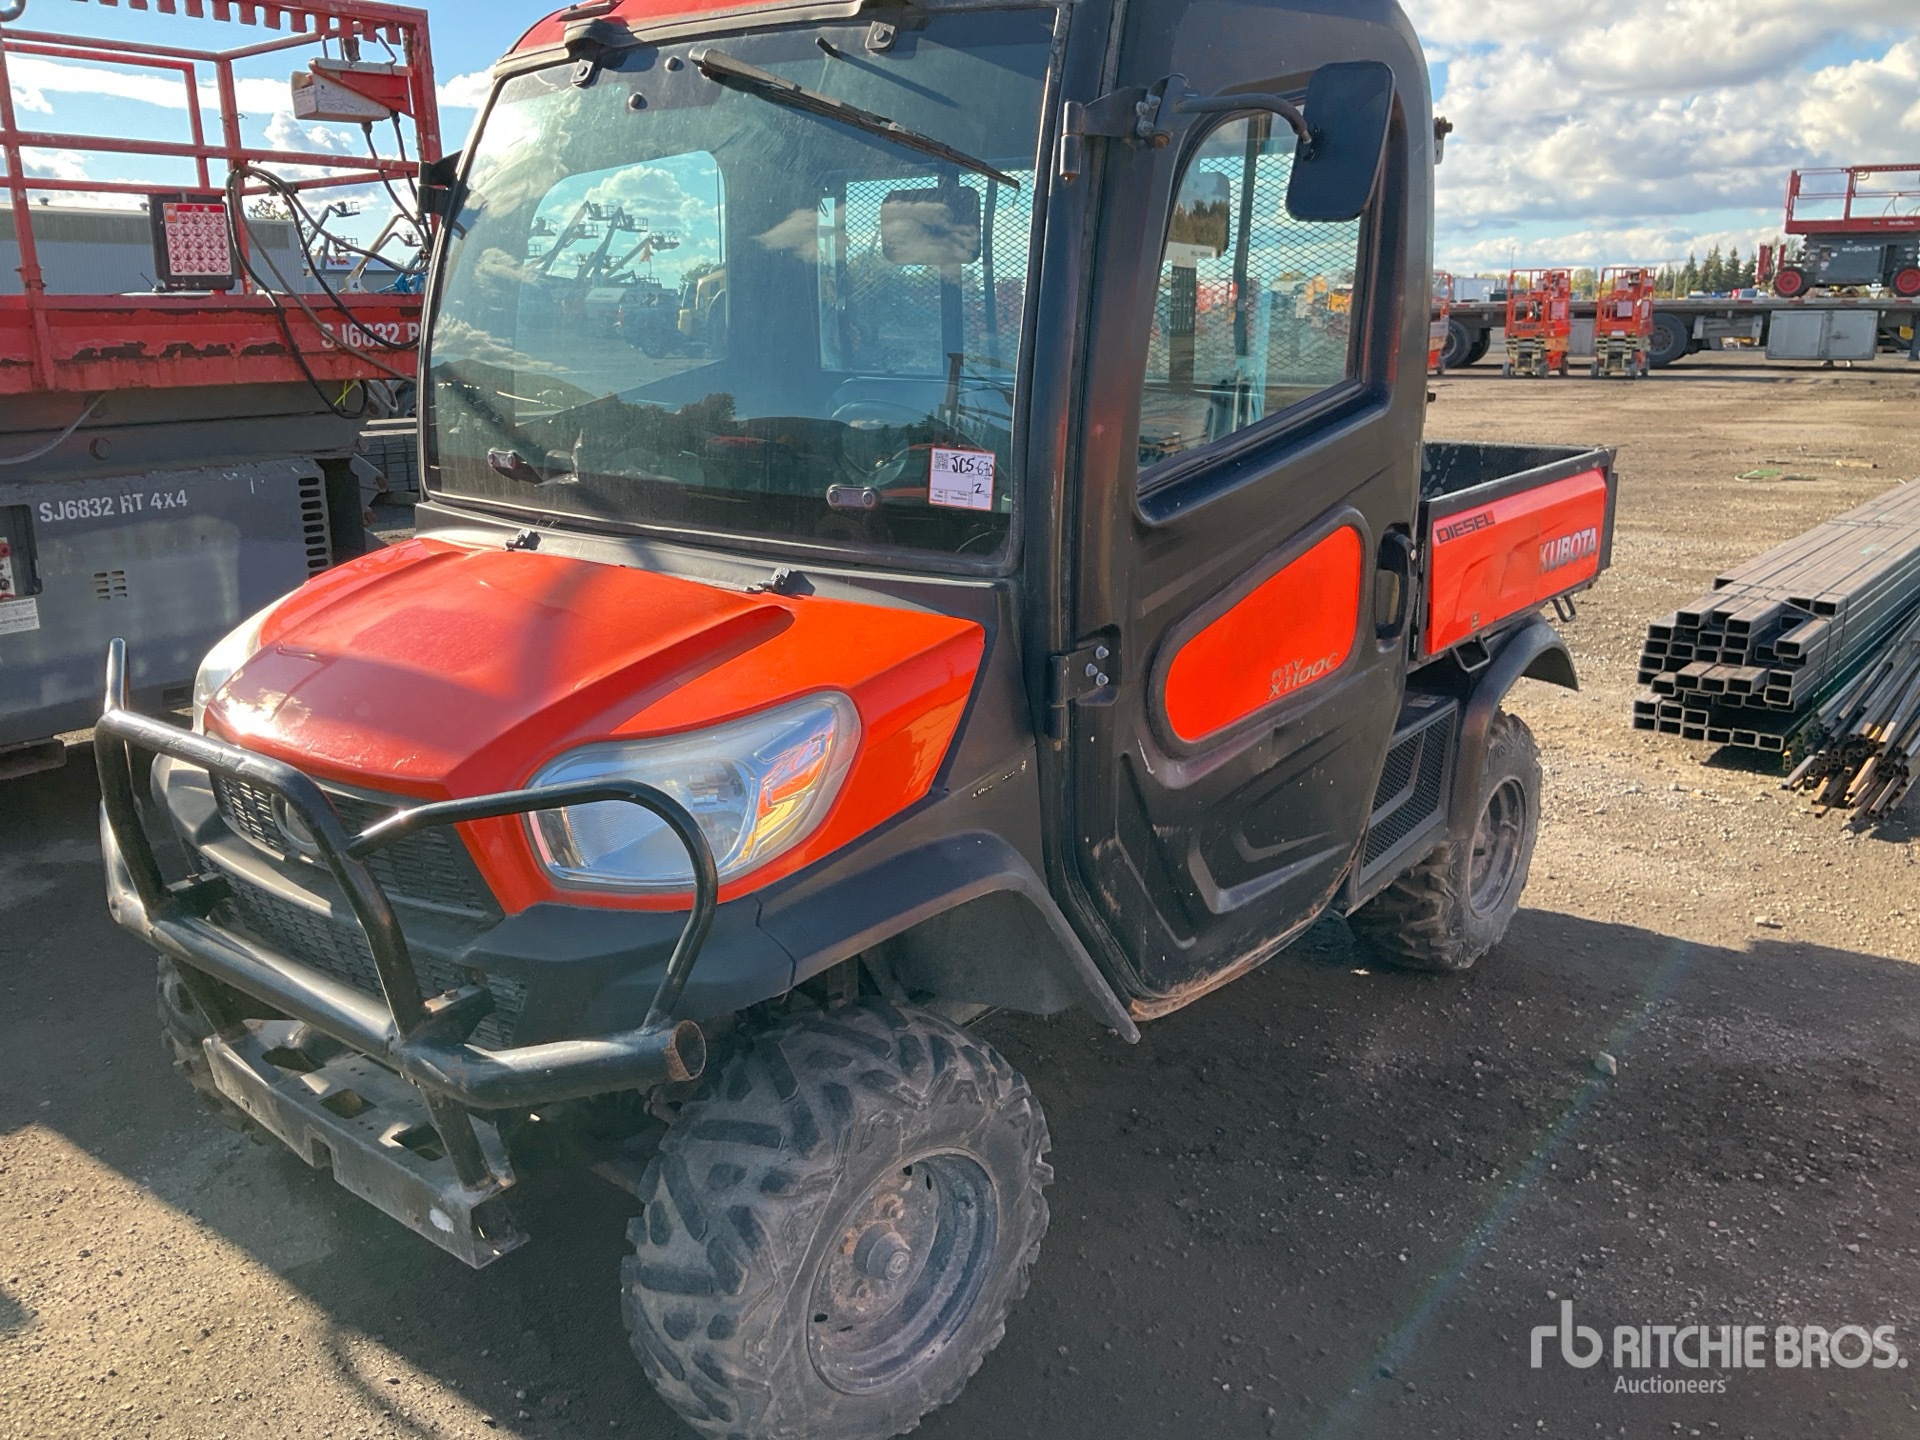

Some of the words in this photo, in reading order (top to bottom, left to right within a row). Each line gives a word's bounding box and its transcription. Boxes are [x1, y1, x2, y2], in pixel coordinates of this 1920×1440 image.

[352, 281, 360, 290] 4
[973, 483, 985, 494] 2
[39, 498, 115, 522] SJ6832
[119, 493, 144, 514] RT
[1435, 510, 1496, 545] DIESEL
[1538, 527, 1597, 575] KUBOTA
[1267, 652, 1338, 700] X1100C
[1271, 657, 1304, 682] RTV
